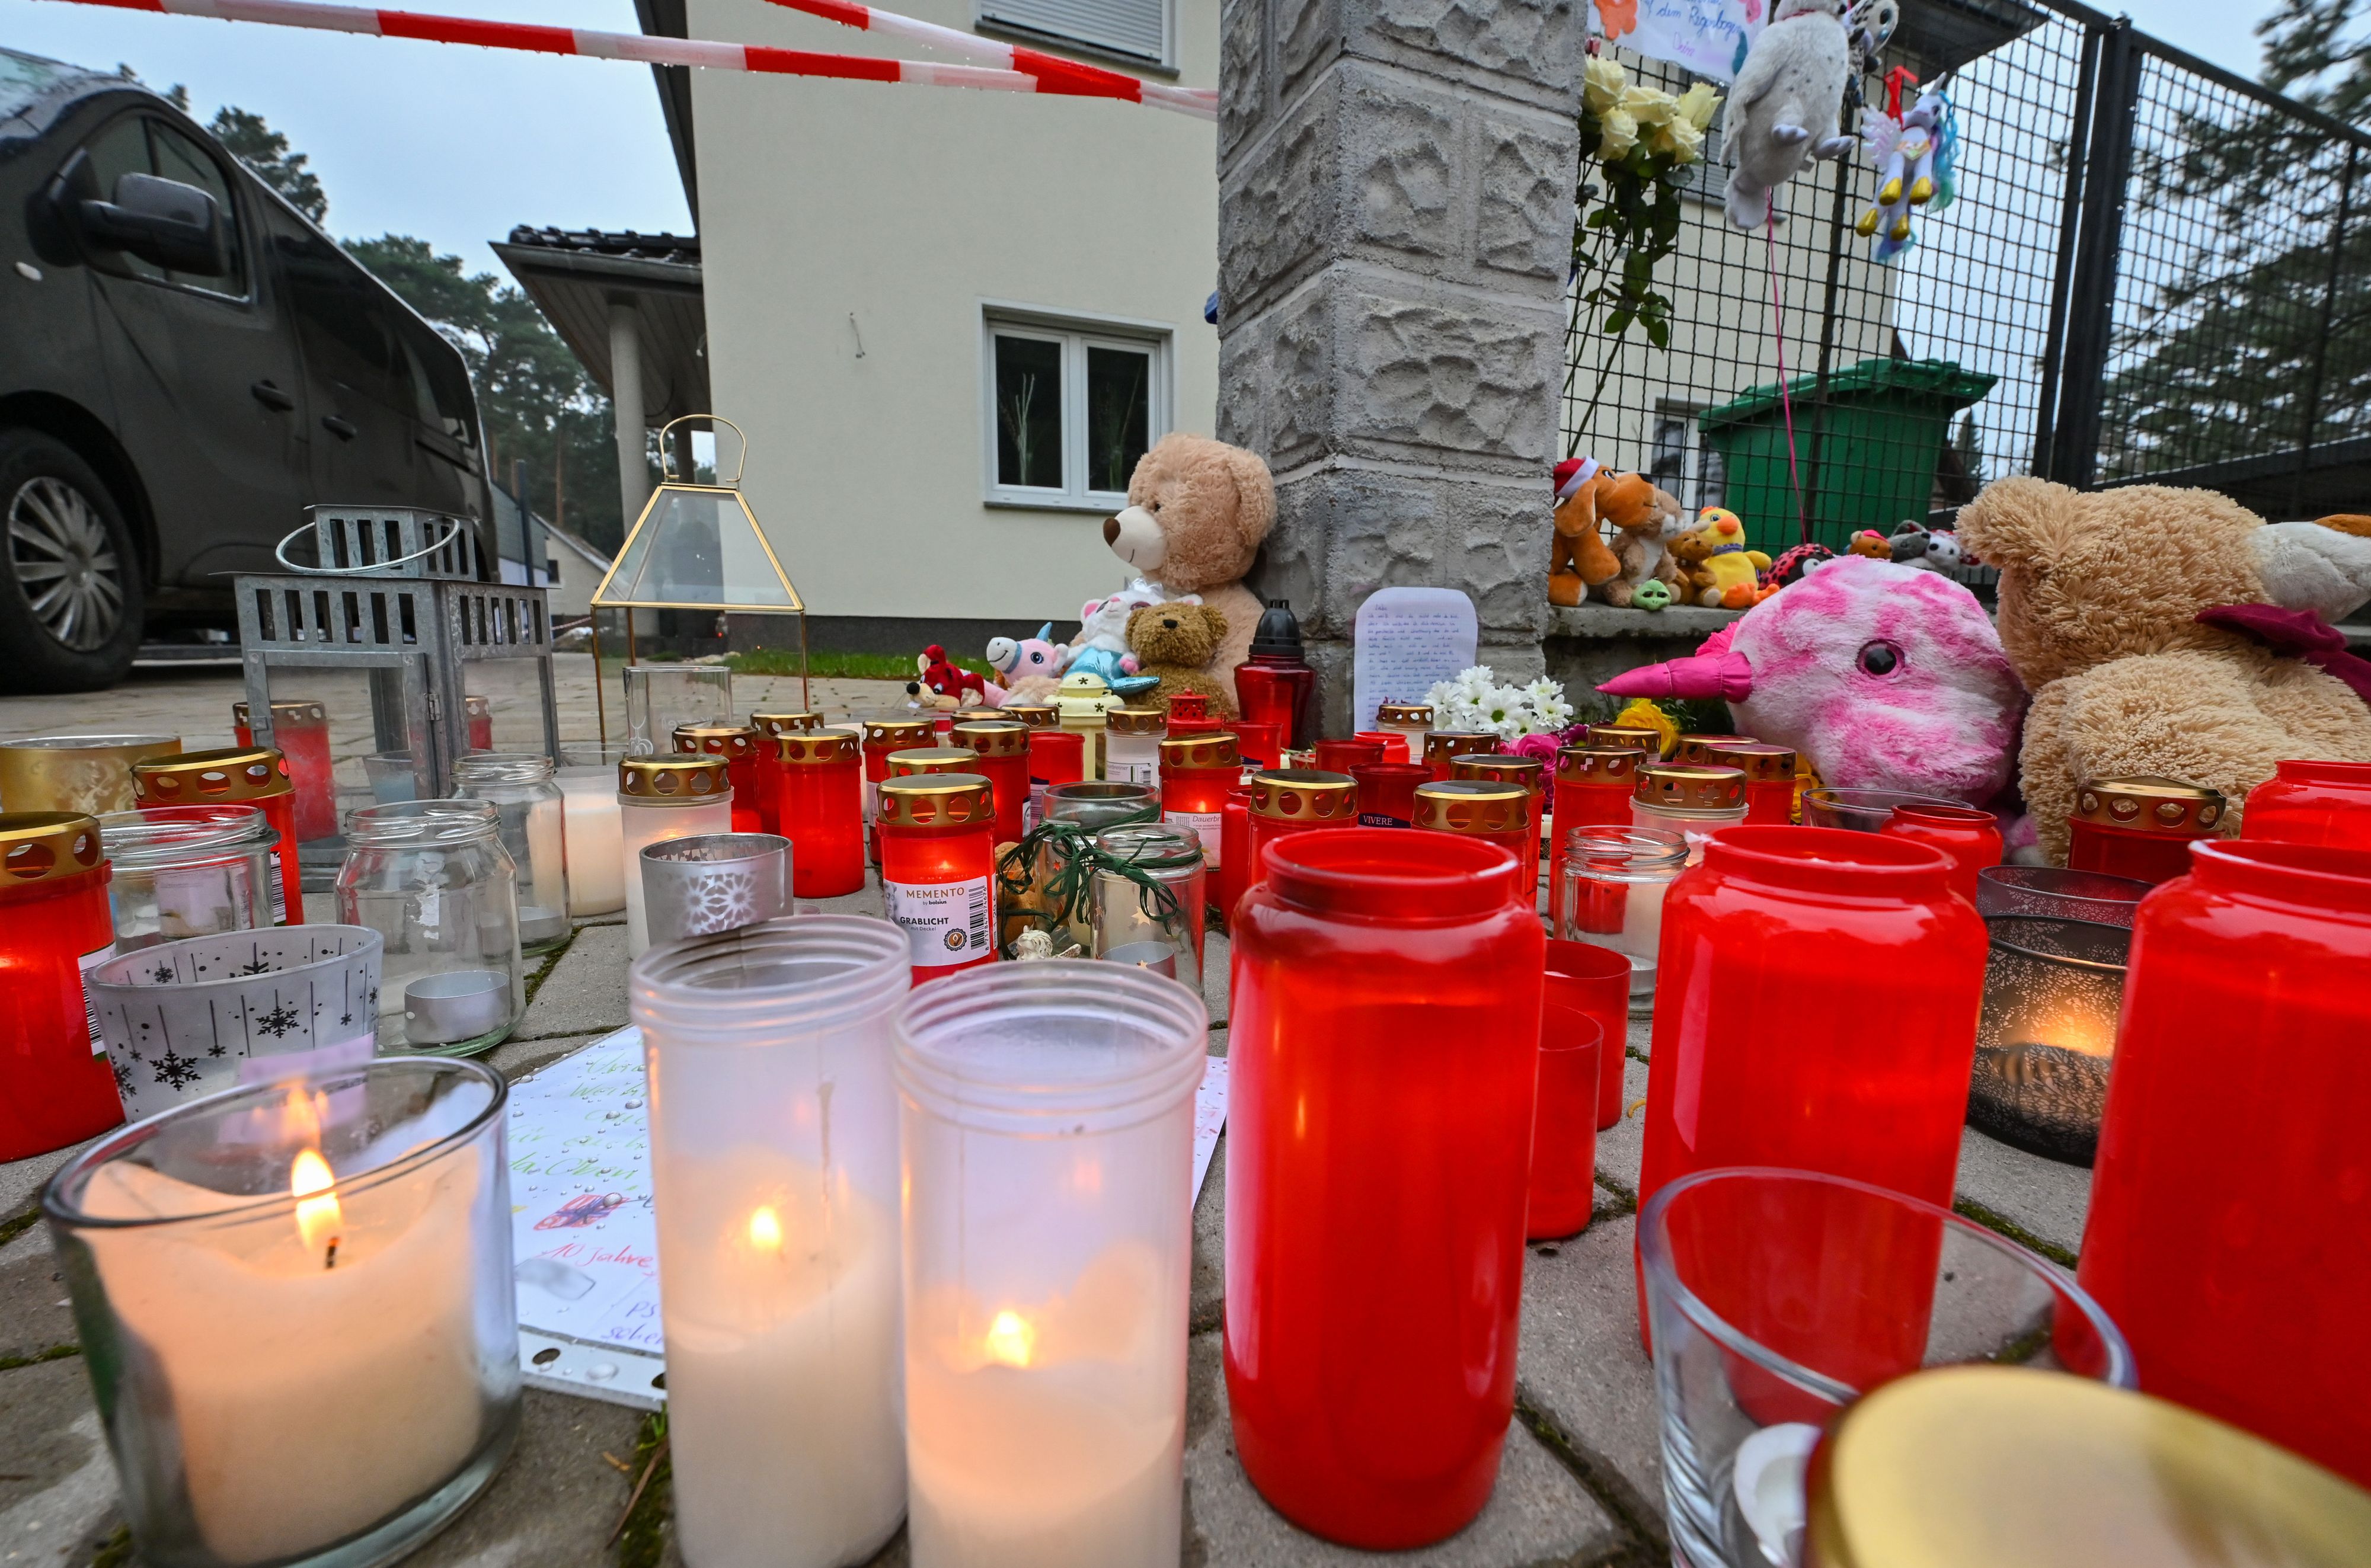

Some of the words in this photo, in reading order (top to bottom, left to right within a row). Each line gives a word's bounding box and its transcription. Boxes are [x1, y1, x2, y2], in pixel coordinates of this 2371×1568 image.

[1363, 815, 1393, 825] VIVERE
[906, 887, 964, 898] MEMENTO
[900, 917, 949, 925] GRABLICHT
[535, 1243, 586, 1259] 10
[575, 1244, 654, 1268] Jahre
